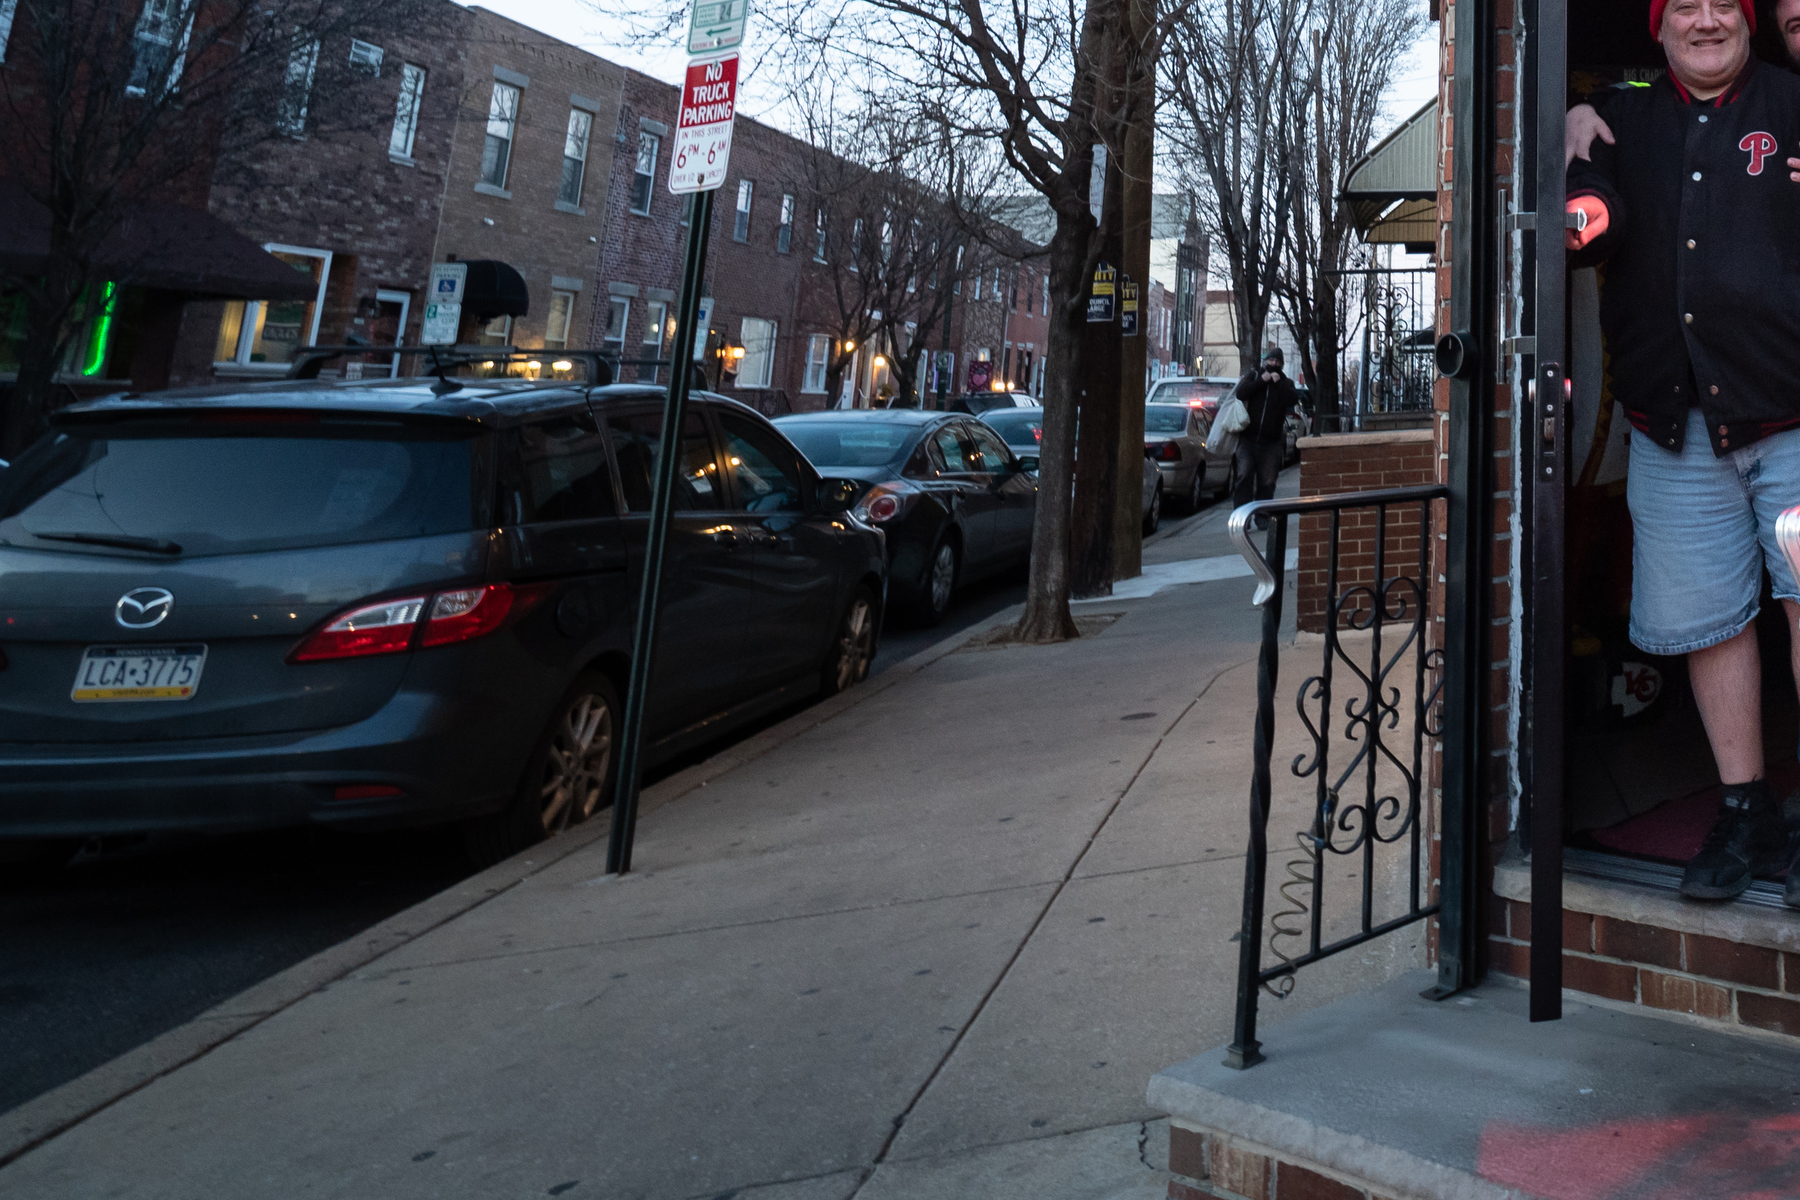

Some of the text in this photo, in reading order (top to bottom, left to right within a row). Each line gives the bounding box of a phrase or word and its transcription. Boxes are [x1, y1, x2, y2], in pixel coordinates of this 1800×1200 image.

[705, 63, 723, 82] NO
[692, 81, 730, 104] TRUCK
[682, 100, 732, 126] PARKING
[682, 124, 728, 139] IN THIS STREET
[677, 145, 686, 168] 6
[688, 143, 699, 156] PM
[707, 141, 715, 165] 6
[717, 140, 726, 152] AM
[1739, 131, 1778, 176] P
